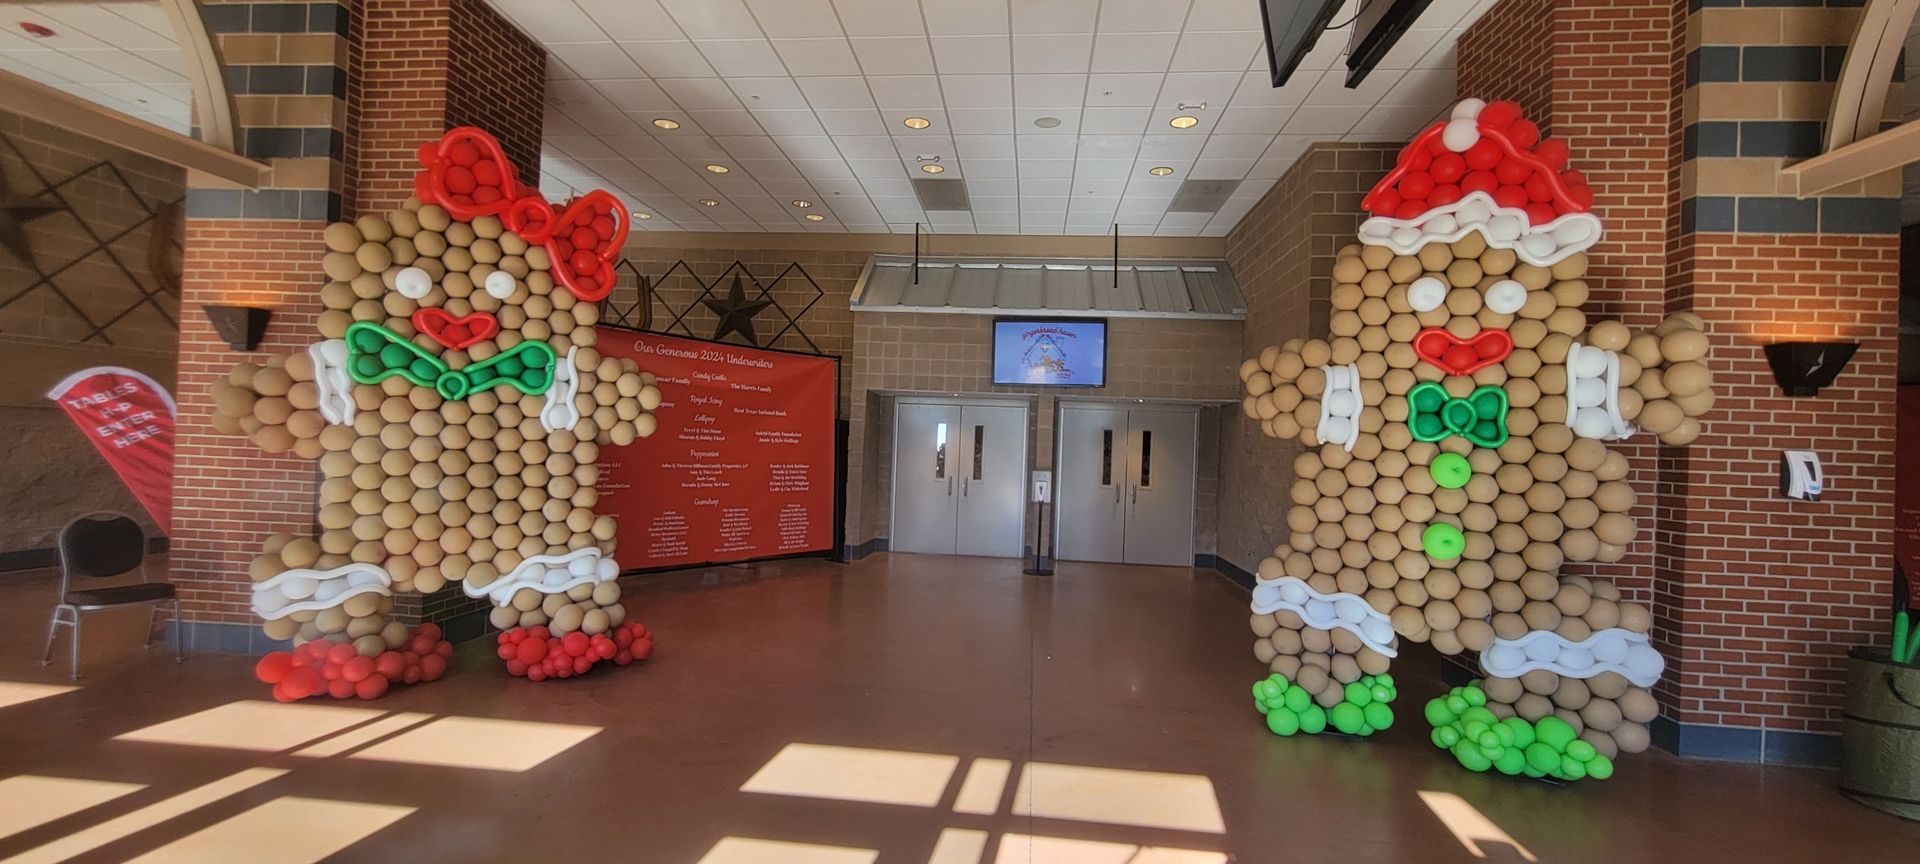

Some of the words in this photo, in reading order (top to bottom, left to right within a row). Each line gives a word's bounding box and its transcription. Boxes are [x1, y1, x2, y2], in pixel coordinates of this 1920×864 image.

[634, 340, 655, 354] Our
[656, 343, 699, 360] Generous
[700, 350, 724, 363] 2024
[726, 353, 774, 369] Underwriters
[672, 377, 691, 386] Family
[692, 371, 711, 382] Candy
[67, 382, 139, 409] TABLES
[757, 386, 772, 394] Family
[690, 395, 708, 406] Royal
[97, 411, 155, 437] ENTER
[694, 415, 716, 424] Lollipop
[113, 425, 161, 448] HERE
[690, 449, 719, 460] Peppermint
[694, 498, 719, 507] Gumdrop
